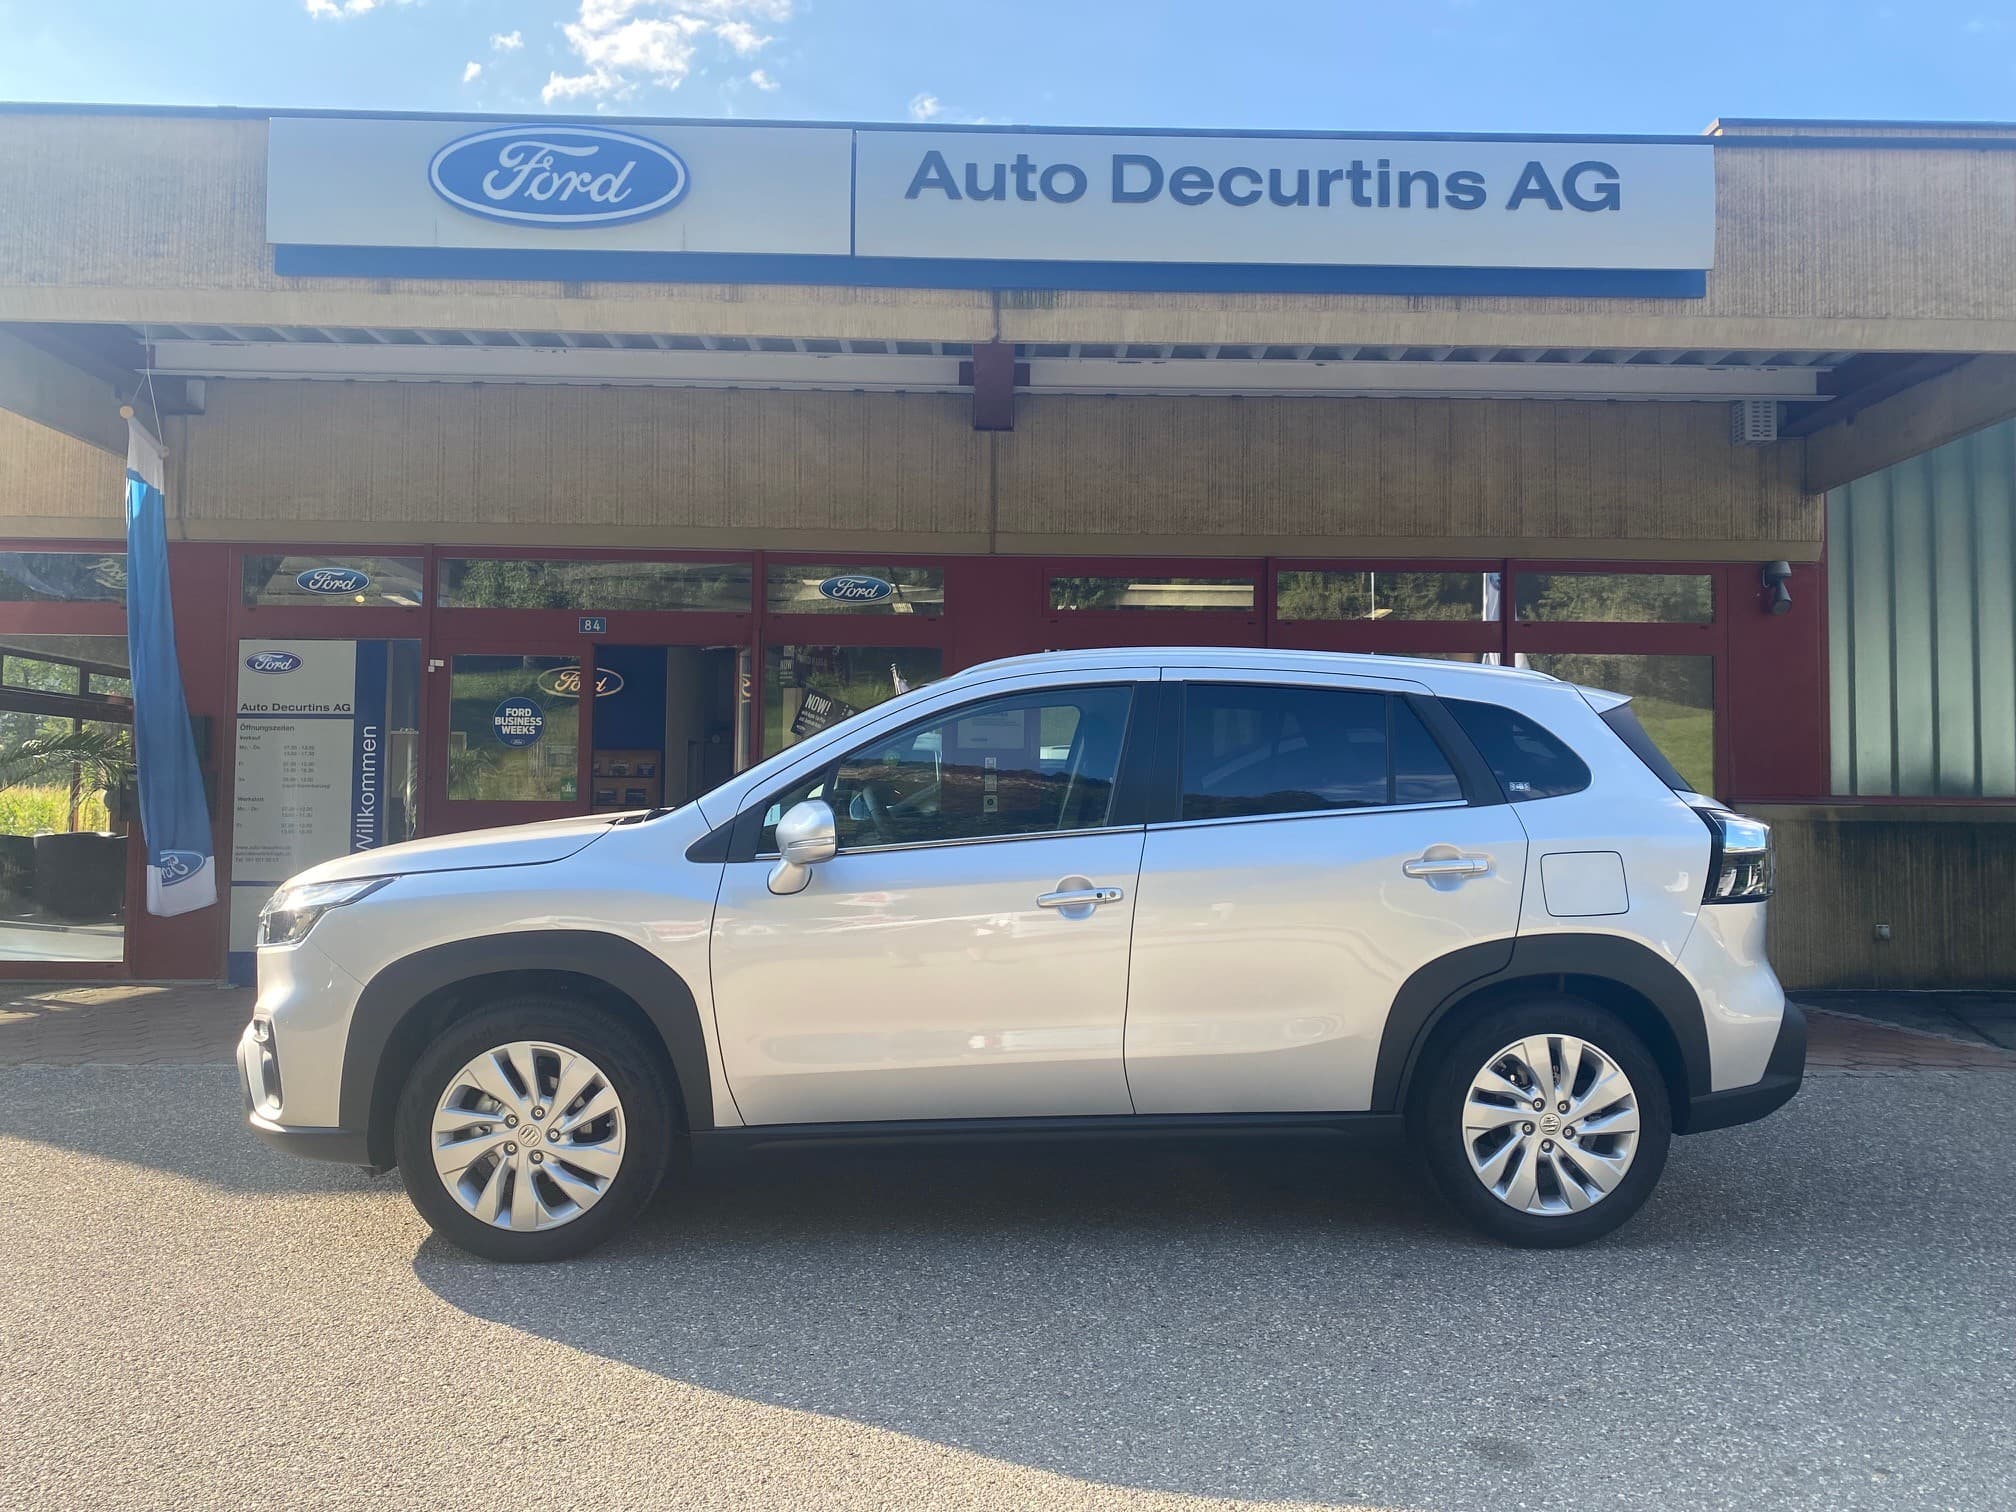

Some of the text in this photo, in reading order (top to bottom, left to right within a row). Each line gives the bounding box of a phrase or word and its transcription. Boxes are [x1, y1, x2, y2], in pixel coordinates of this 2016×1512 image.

[483, 141, 636, 203] Ford
[905, 150, 1621, 212] Auto Decurtins AG
[309, 571, 357, 591] Ford
[832, 578, 880, 598] Ford
[584, 619, 601, 631] 84
[254, 653, 293, 670] Ford
[555, 670, 607, 692] Fod
[240, 703, 351, 712] Auto Decurtins AG
[505, 707, 532, 717] FORD
[805, 693, 832, 716] NOW!
[494, 716, 543, 726] BUSINESS
[501, 725, 536, 735] WEEKS
[355, 725, 377, 851] Willkommen
